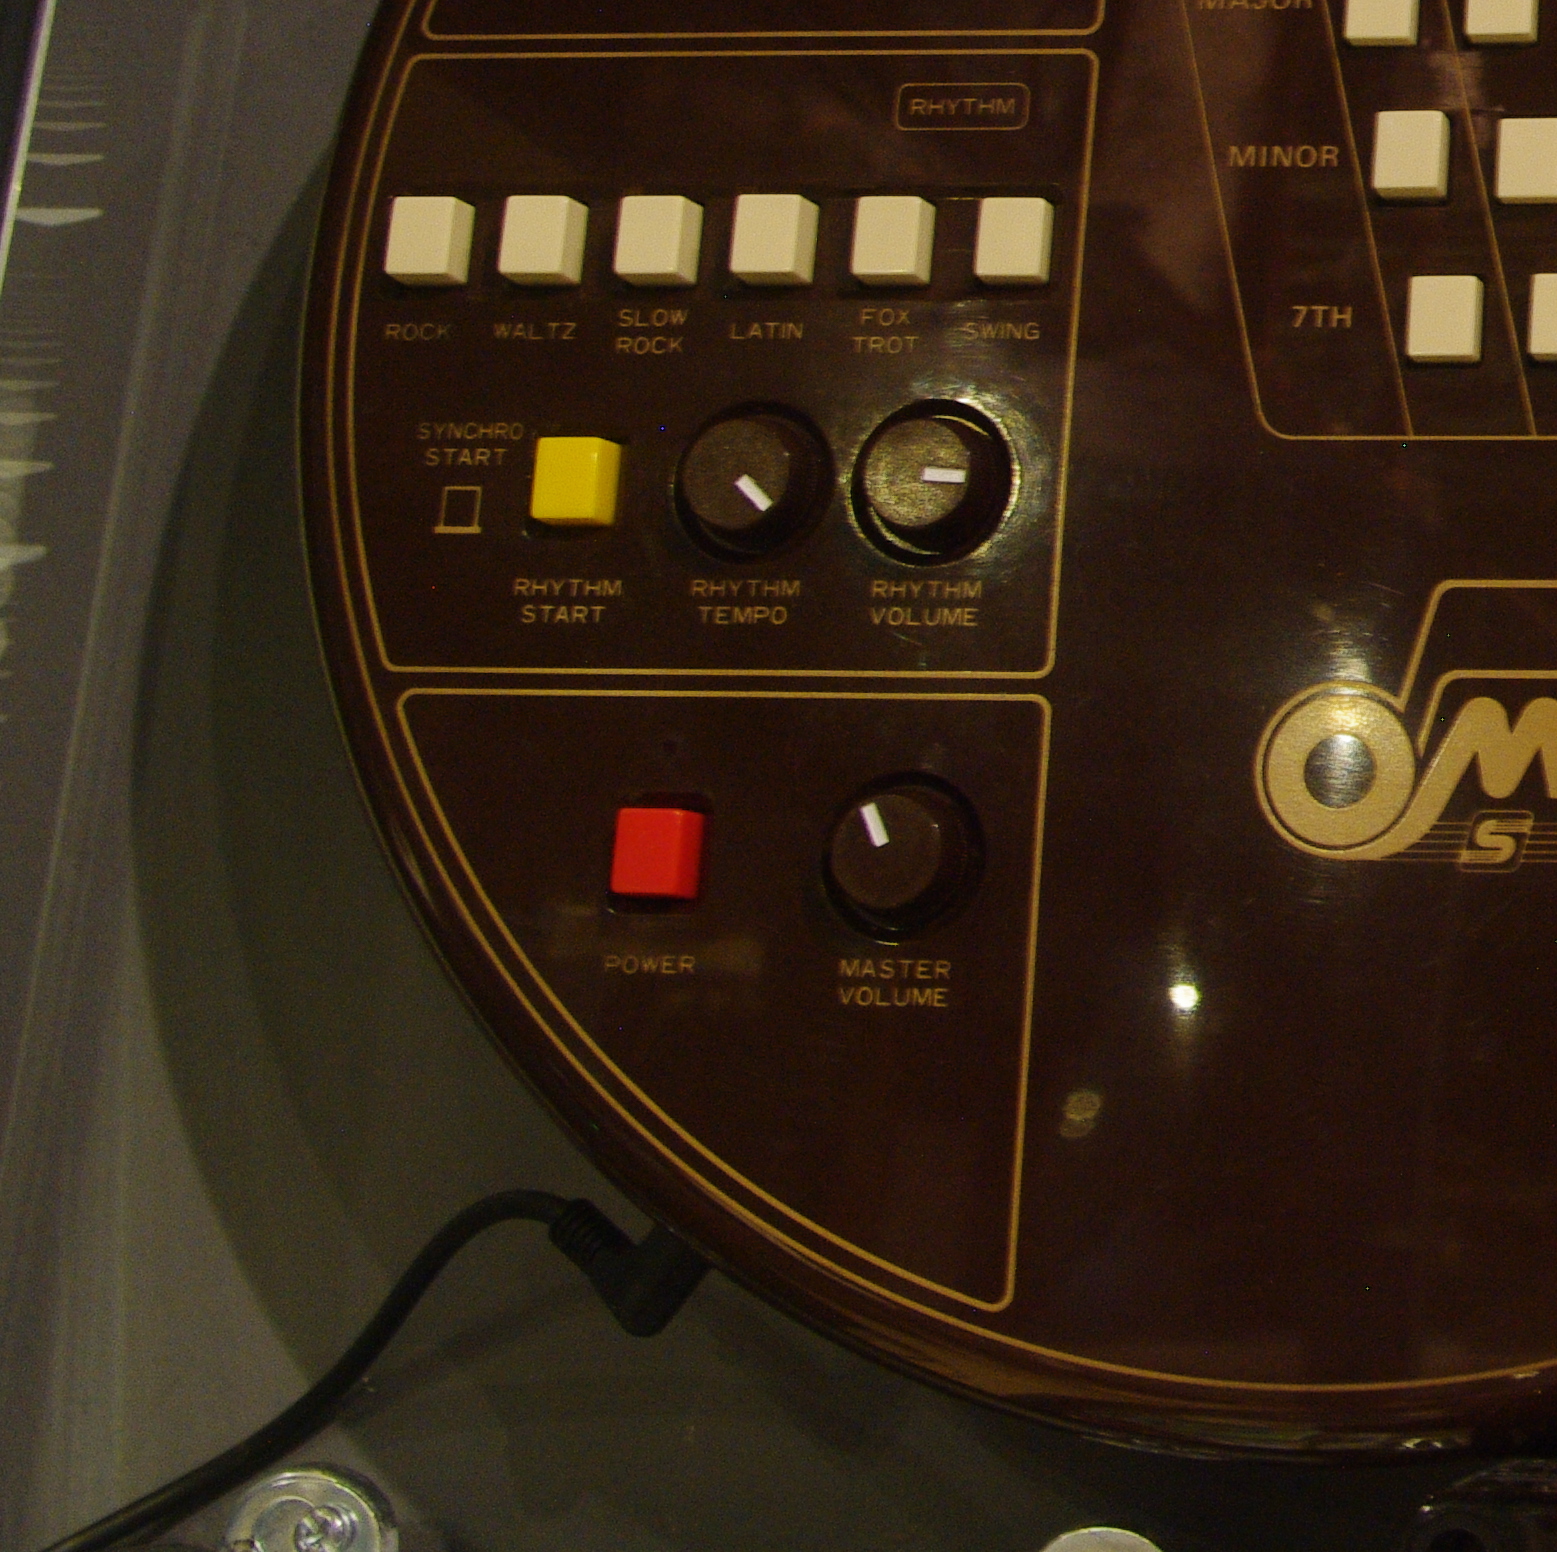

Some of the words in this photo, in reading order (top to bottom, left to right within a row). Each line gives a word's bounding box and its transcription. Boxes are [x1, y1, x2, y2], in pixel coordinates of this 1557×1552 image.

[907, 97, 1017, 116] RHYTHM
[1228, 145, 1340, 168] MINOR
[616, 308, 688, 327] SLOW
[860, 308, 911, 326] FOX
[1291, 306, 1353, 329] 7TH
[384, 323, 453, 341] ROCK
[493, 322, 578, 341] WALTZ
[729, 322, 804, 341] LATIN
[963, 322, 1042, 342] SWING
[614, 336, 686, 355] ROCK
[851, 336, 919, 355] TROT
[417, 422, 524, 441] SYNCHRO
[425, 448, 508, 467] START
[512, 579, 623, 599] RHYTHM
[691, 579, 802, 599] RHYTHM
[870, 579, 984, 599] RHYTHM
[520, 605, 606, 625] START
[697, 606, 789, 626] TEMPO
[869, 607, 980, 628] VOLUME
[604, 955, 697, 975] POWER
[838, 958, 953, 980] MASTER
[838, 987, 950, 1008] VOLUME
